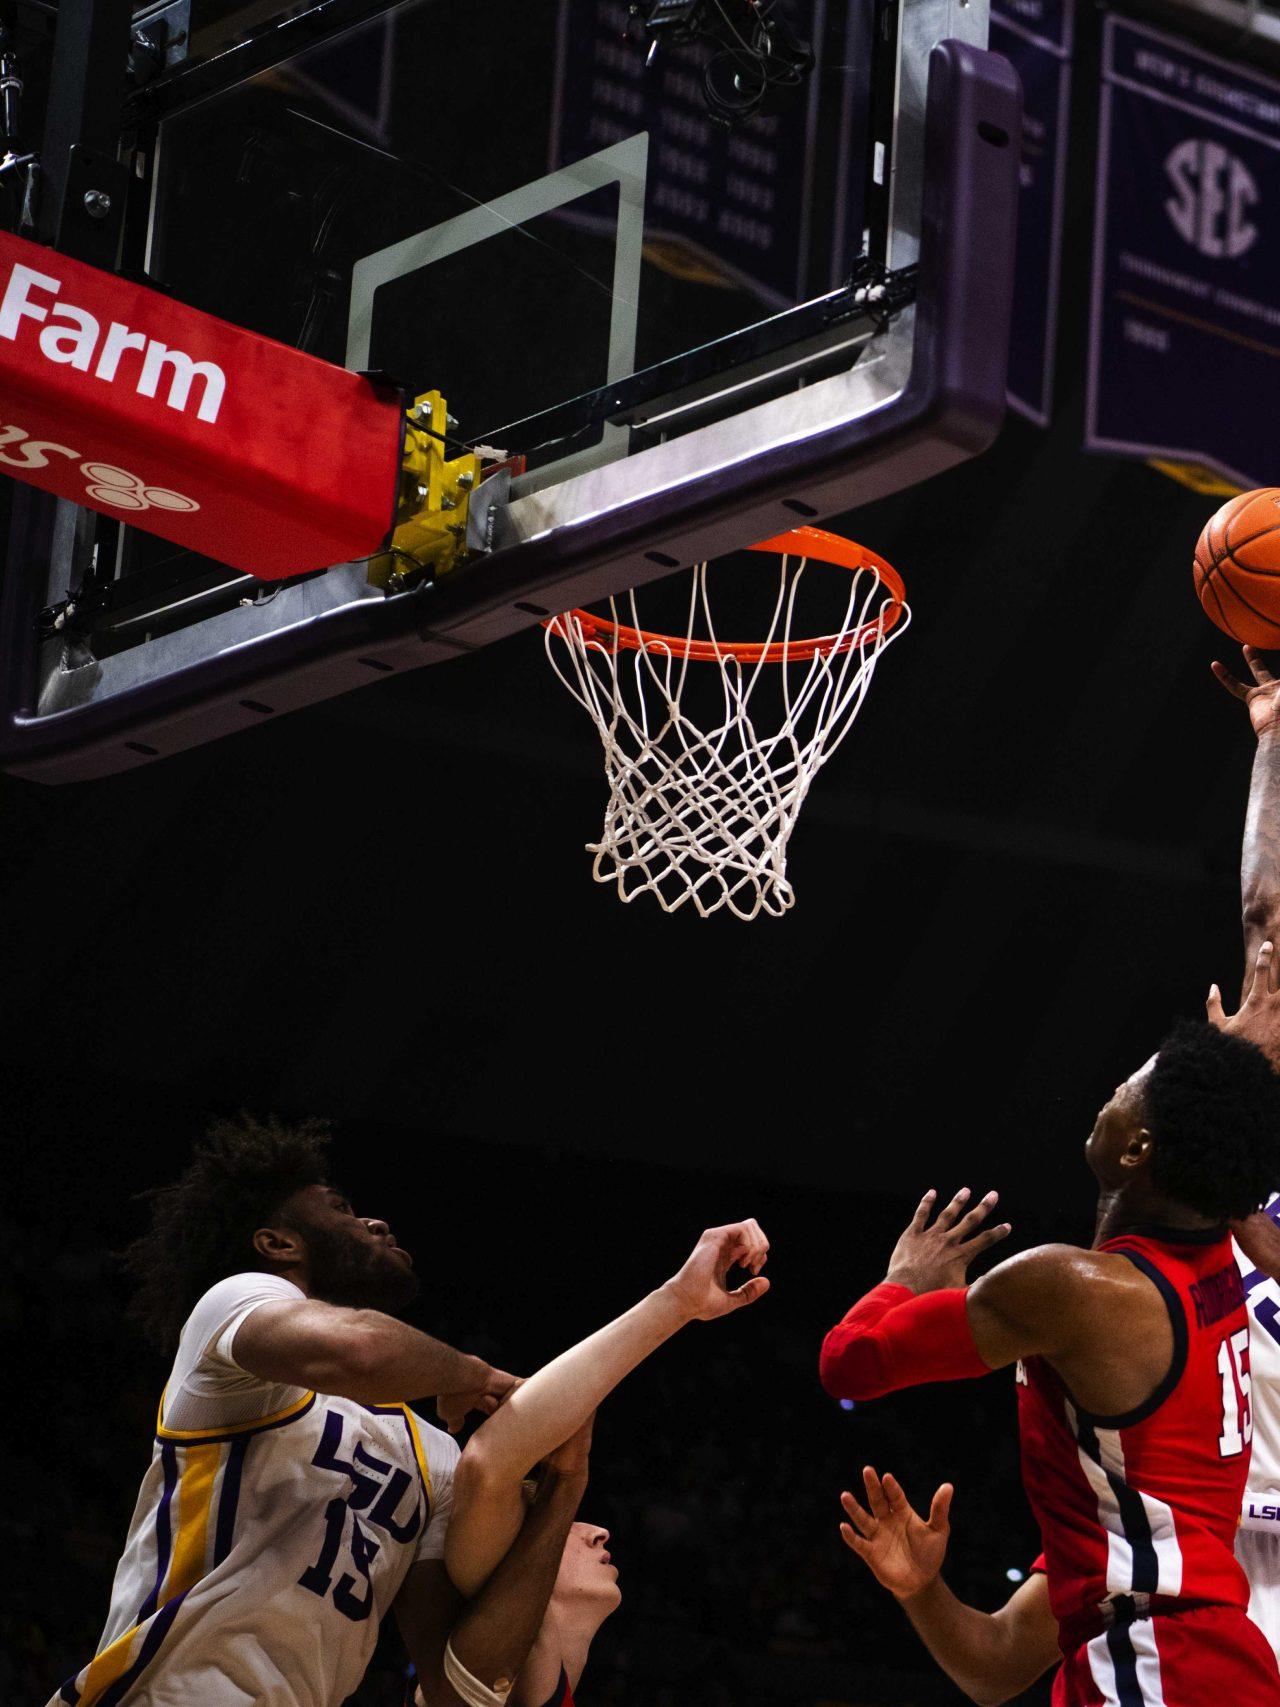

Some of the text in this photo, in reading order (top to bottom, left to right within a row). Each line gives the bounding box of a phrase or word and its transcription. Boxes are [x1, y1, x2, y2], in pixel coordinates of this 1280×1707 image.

[1162, 136, 1260, 259] SEC
[0, 263, 227, 424] Farm
[311, 1410, 420, 1543] LSU
